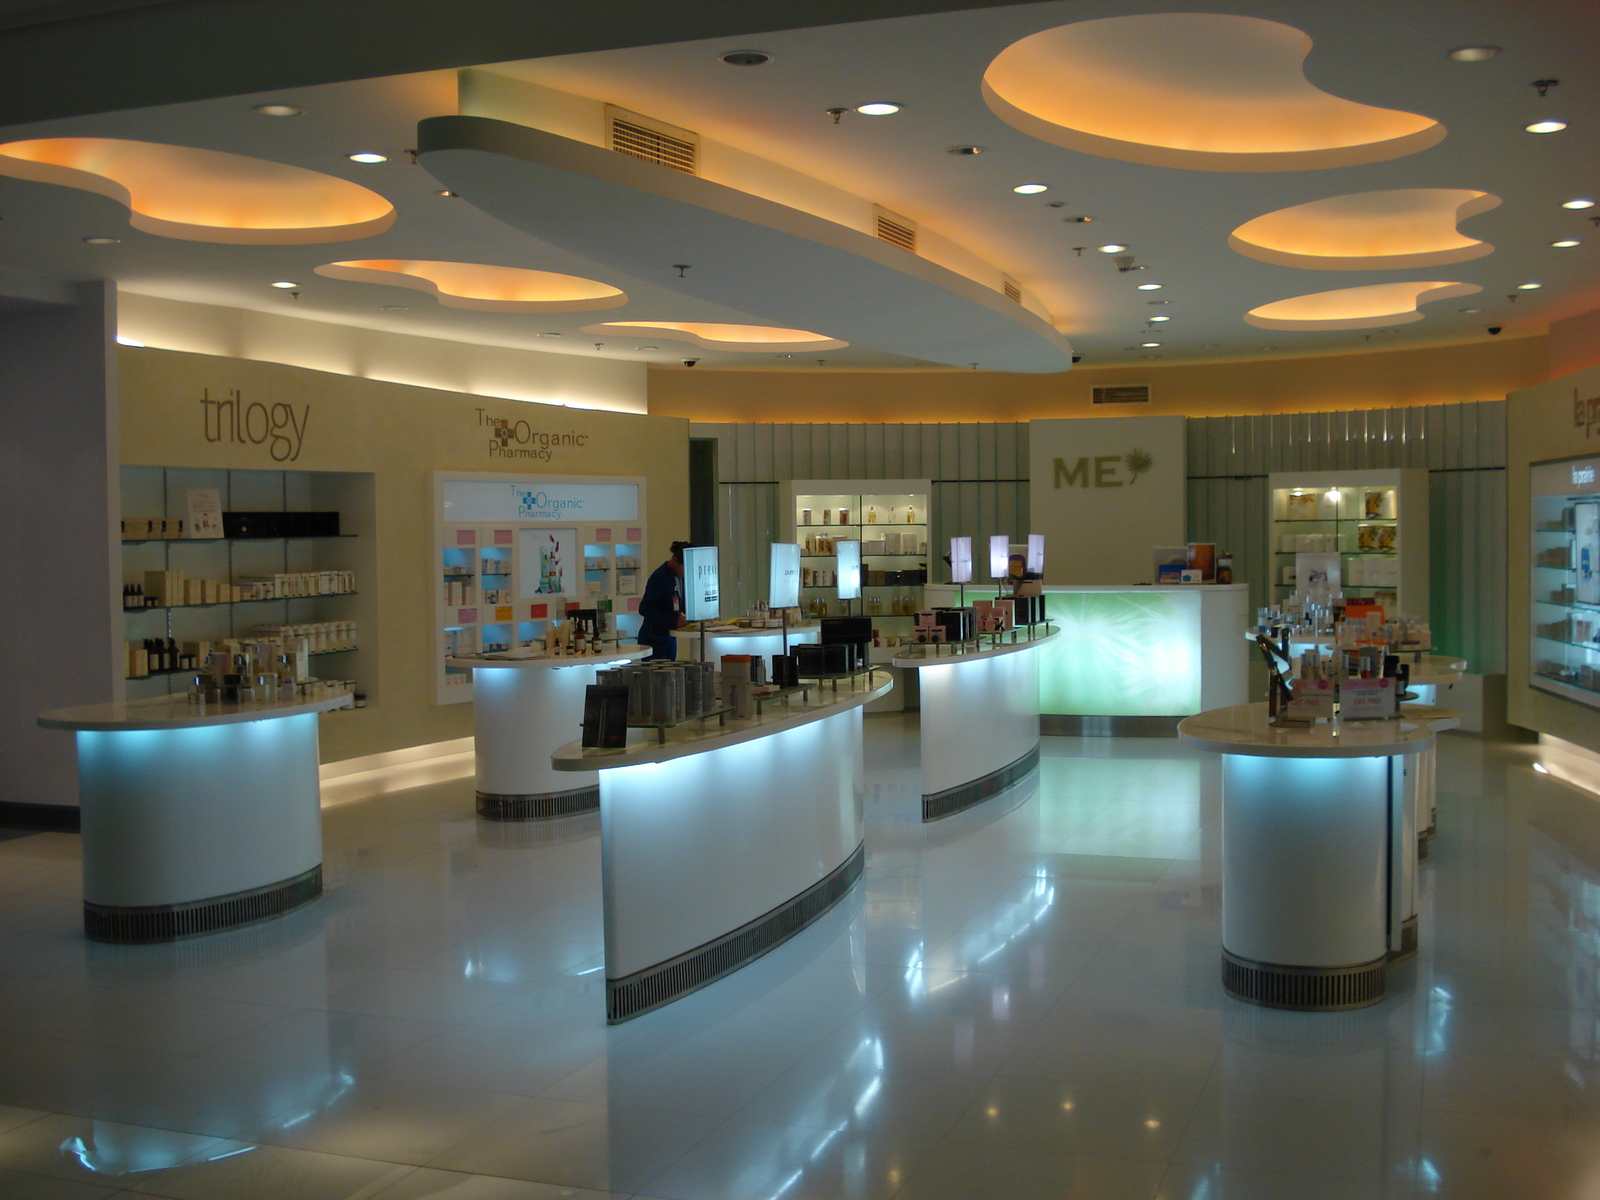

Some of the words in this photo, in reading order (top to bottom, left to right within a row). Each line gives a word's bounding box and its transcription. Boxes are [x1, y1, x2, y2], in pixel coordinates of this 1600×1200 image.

[200, 388, 310, 462] trilogy
[475, 408, 500, 428] The
[514, 419, 584, 449] Organic
[489, 439, 553, 462] Pharmacy
[1053, 455, 1123, 489] ME
[509, 485, 527, 498] The
[536, 492, 582, 511] Organic
[518, 506, 562, 520] Pharmacy
